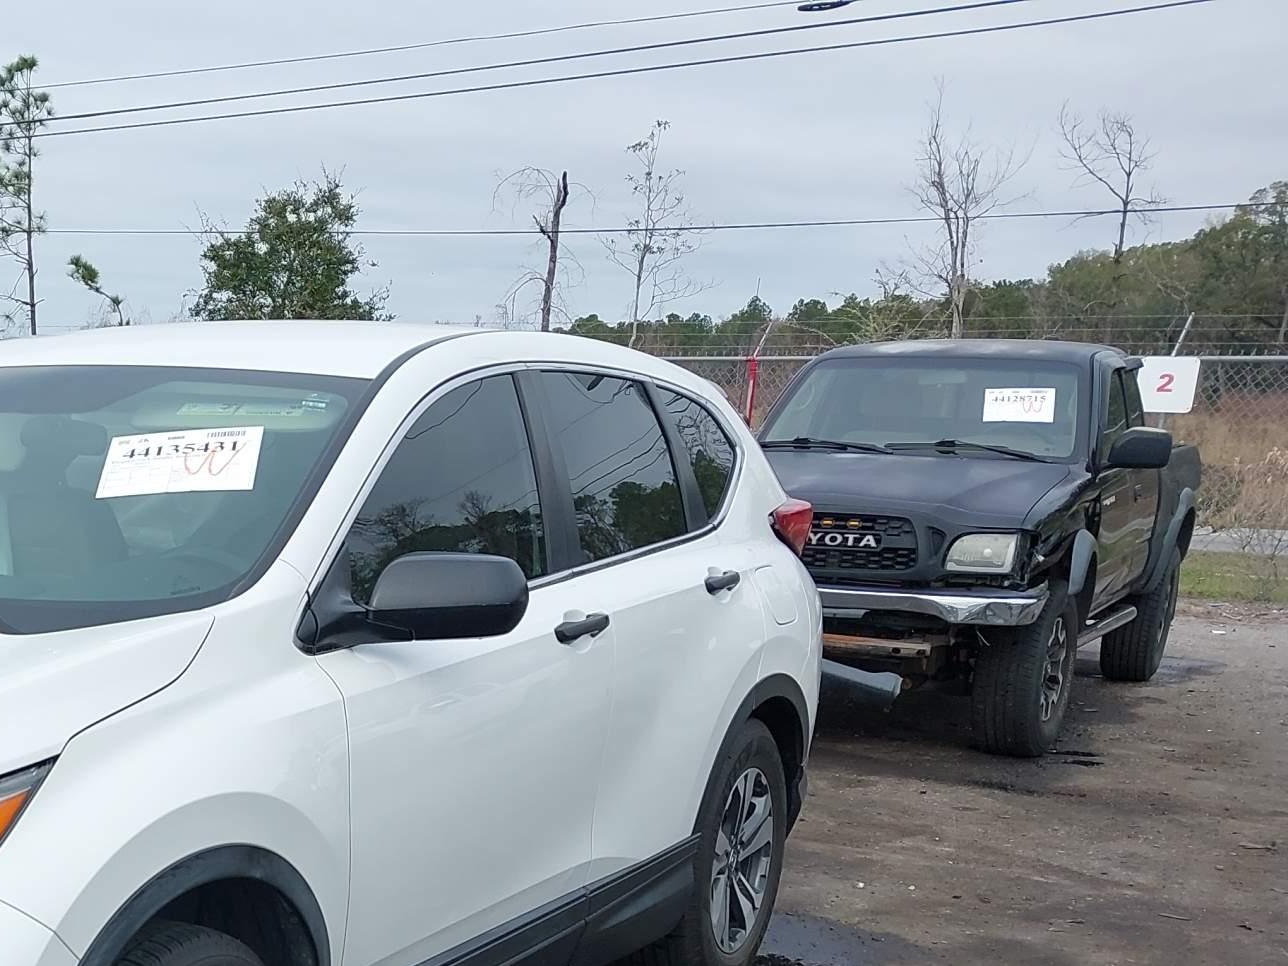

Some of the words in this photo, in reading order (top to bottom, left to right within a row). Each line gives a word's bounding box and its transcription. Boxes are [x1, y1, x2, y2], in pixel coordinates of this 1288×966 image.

[1156, 373, 1175, 393] 2
[122, 440, 240, 460] 44135431
[808, 532, 878, 548] YOTA
